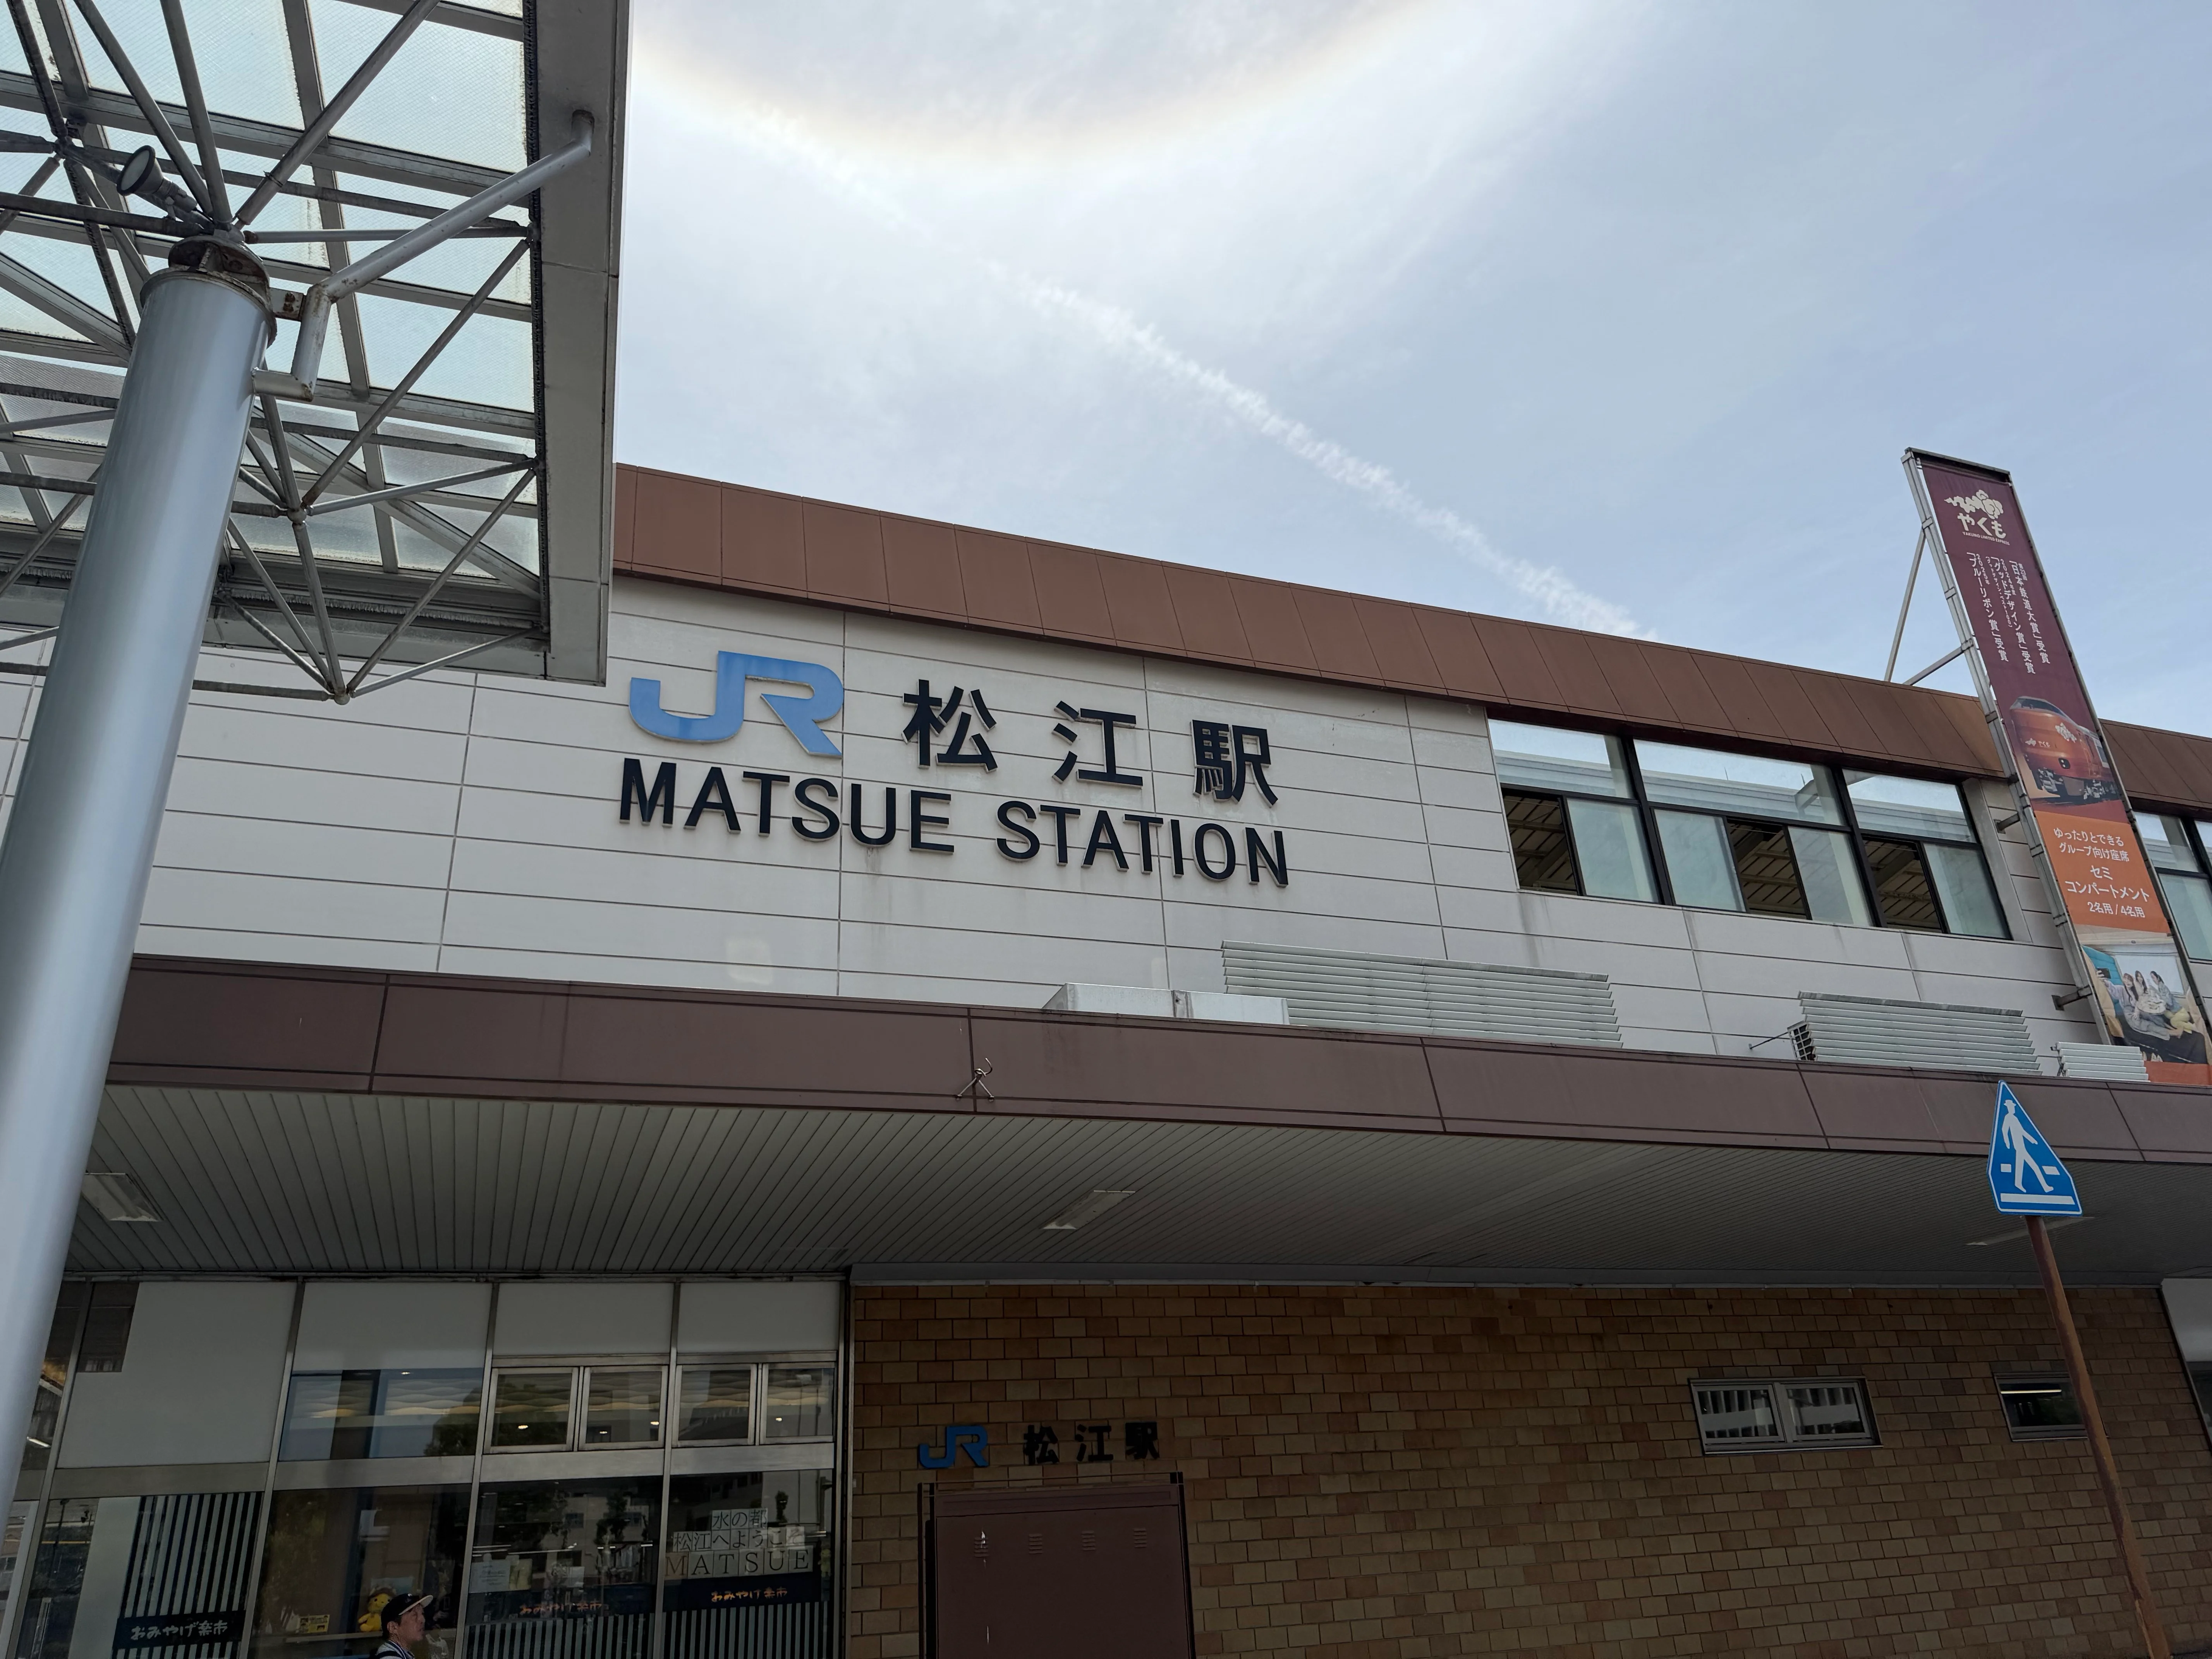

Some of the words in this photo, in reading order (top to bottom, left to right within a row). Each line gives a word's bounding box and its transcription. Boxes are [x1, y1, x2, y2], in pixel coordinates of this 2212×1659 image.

[1958, 513, 2006, 538] やくも
[1976, 554, 1990, 585] 2025年
[1966, 552, 2009, 661] 「ブルーリボン賞」受賞
[1990, 556, 2035, 674] 「グッドデザイン賞」受賞
[629, 650, 844, 758] JR
[902, 679, 1278, 807] 松江駅
[619, 758, 955, 854] MATSUE
[996, 800, 1288, 888] STATION
[2054, 828, 2124, 847] ゆったりとできる
[2059, 842, 2130, 862] グループ向け座席
[2090, 865, 2113, 880] セミ
[2065, 881, 2149, 902] コンパートメント
[917, 1425, 988, 1469] JR
[1023, 1421, 1160, 1465] 松江駅
[713, 1509, 767, 1529] 水の都
[675, 1527, 800, 1551] 松江へようこそ
[666, 1549, 809, 1576] MATSUE
[131, 1620, 228, 1640] おみやげ楽市
